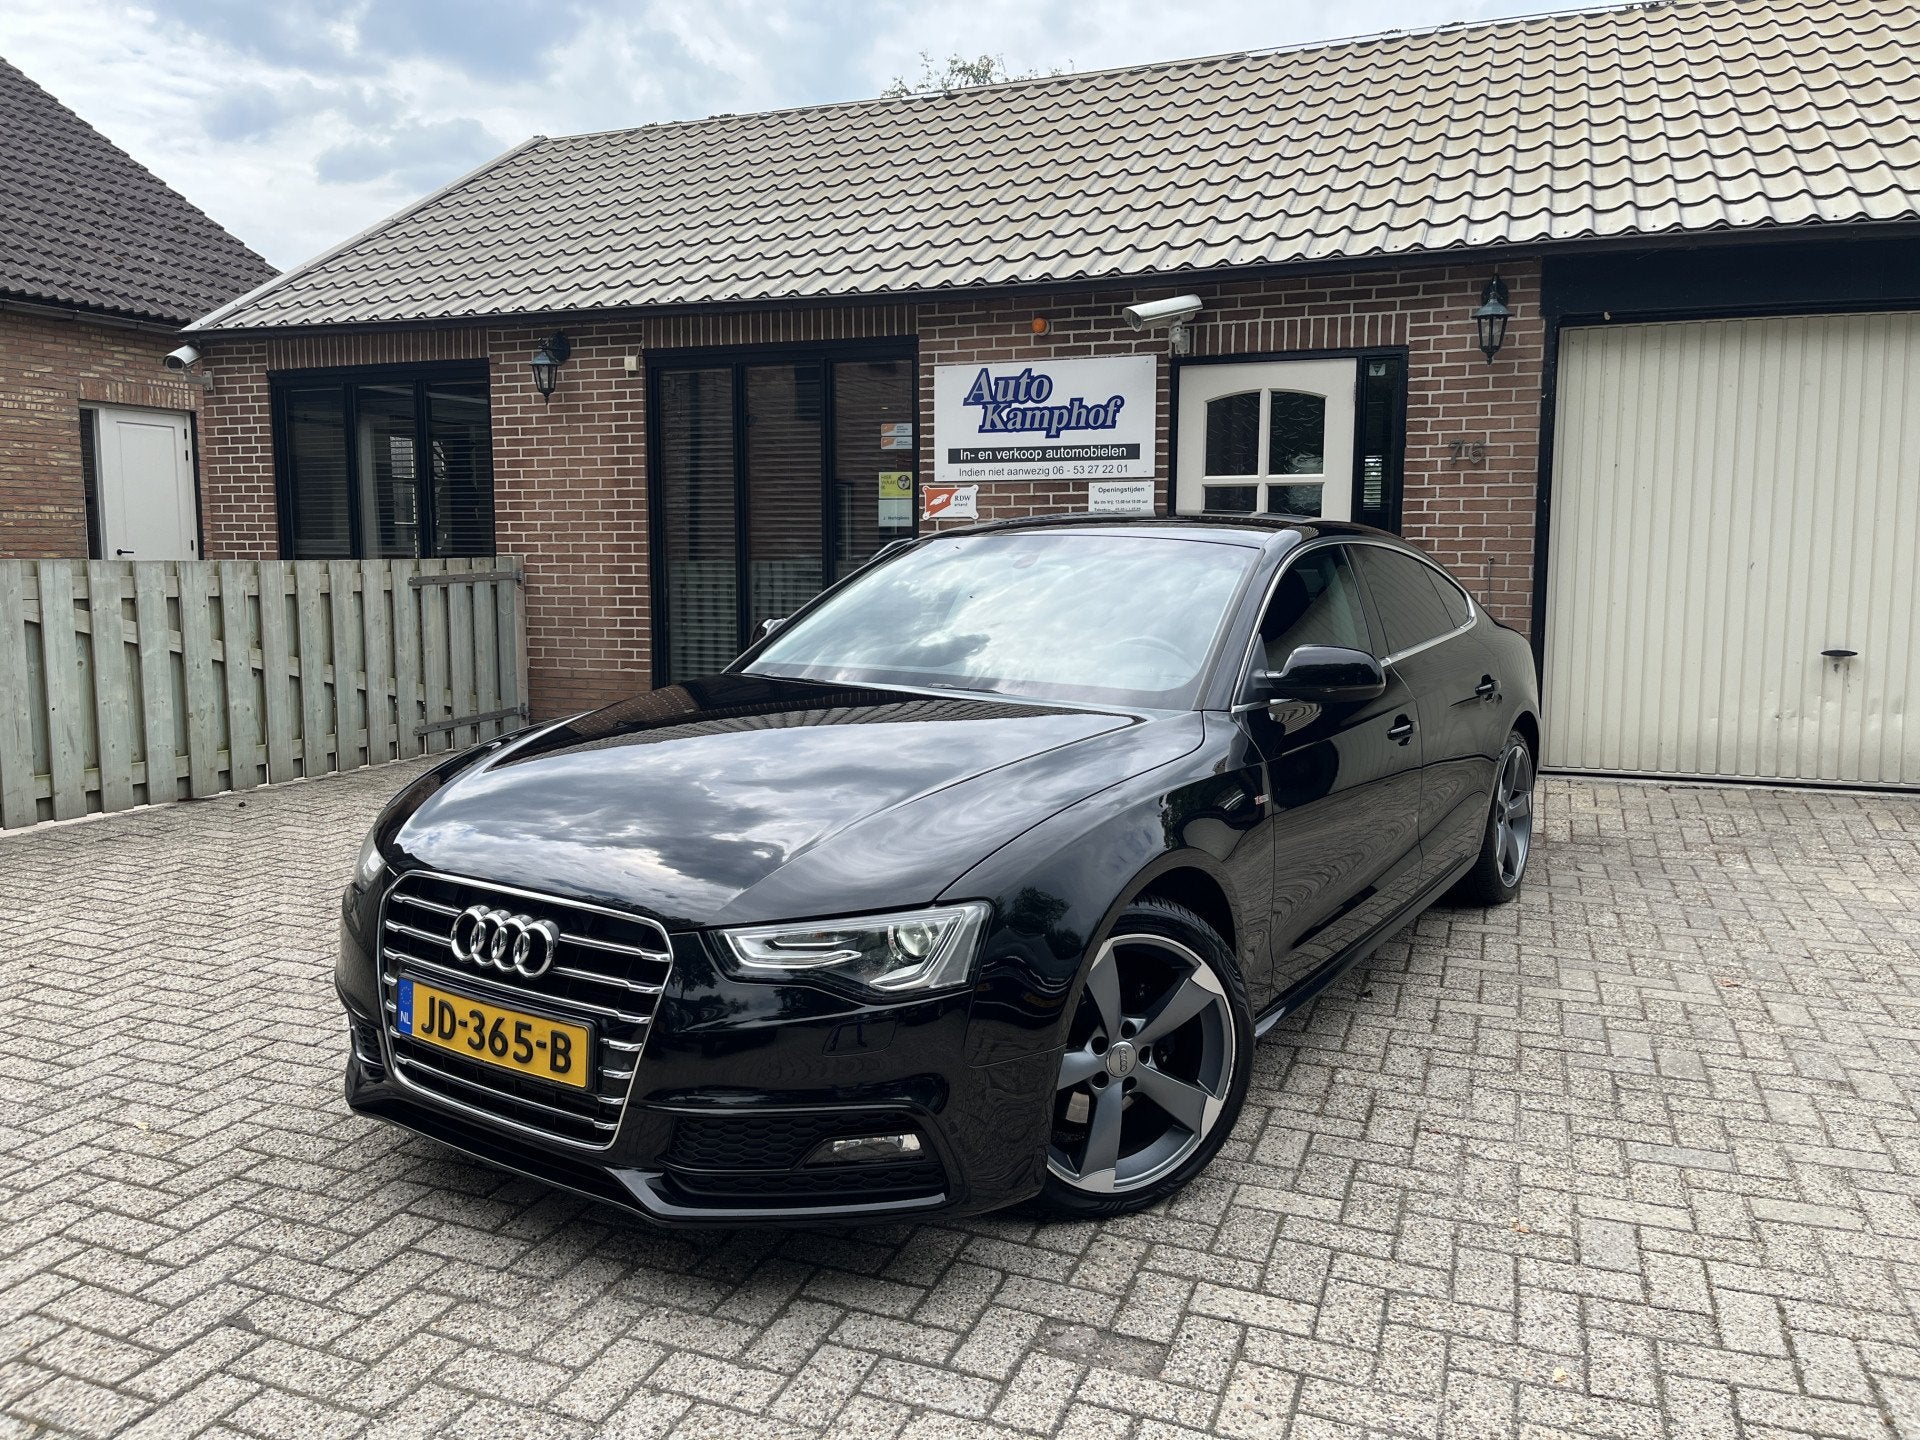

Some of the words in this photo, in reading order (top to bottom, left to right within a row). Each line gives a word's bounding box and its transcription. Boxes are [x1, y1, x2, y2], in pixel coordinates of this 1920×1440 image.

[963, 368, 1053, 404] Auto
[978, 395, 1125, 438] Kamphof
[960, 449, 975, 461] In-
[978, 451, 992, 460] en
[996, 447, 1042, 462] verkoop
[1045, 445, 1127, 459] automobielen
[959, 467, 986, 477] Indien
[988, 467, 1005, 476] niet
[1007, 465, 1050, 477] aanwezig
[1052, 465, 1064, 475] 06
[1073, 465, 1085, 475] 53
[1088, 464, 1099, 474] 27
[1102, 464, 1114, 474] 22
[1116, 464, 1128, 474] 01
[1098, 486, 1145, 494] Openingstijden
[400, 1010, 411, 1026] NL
[421, 996, 572, 1074] JD-365-B
